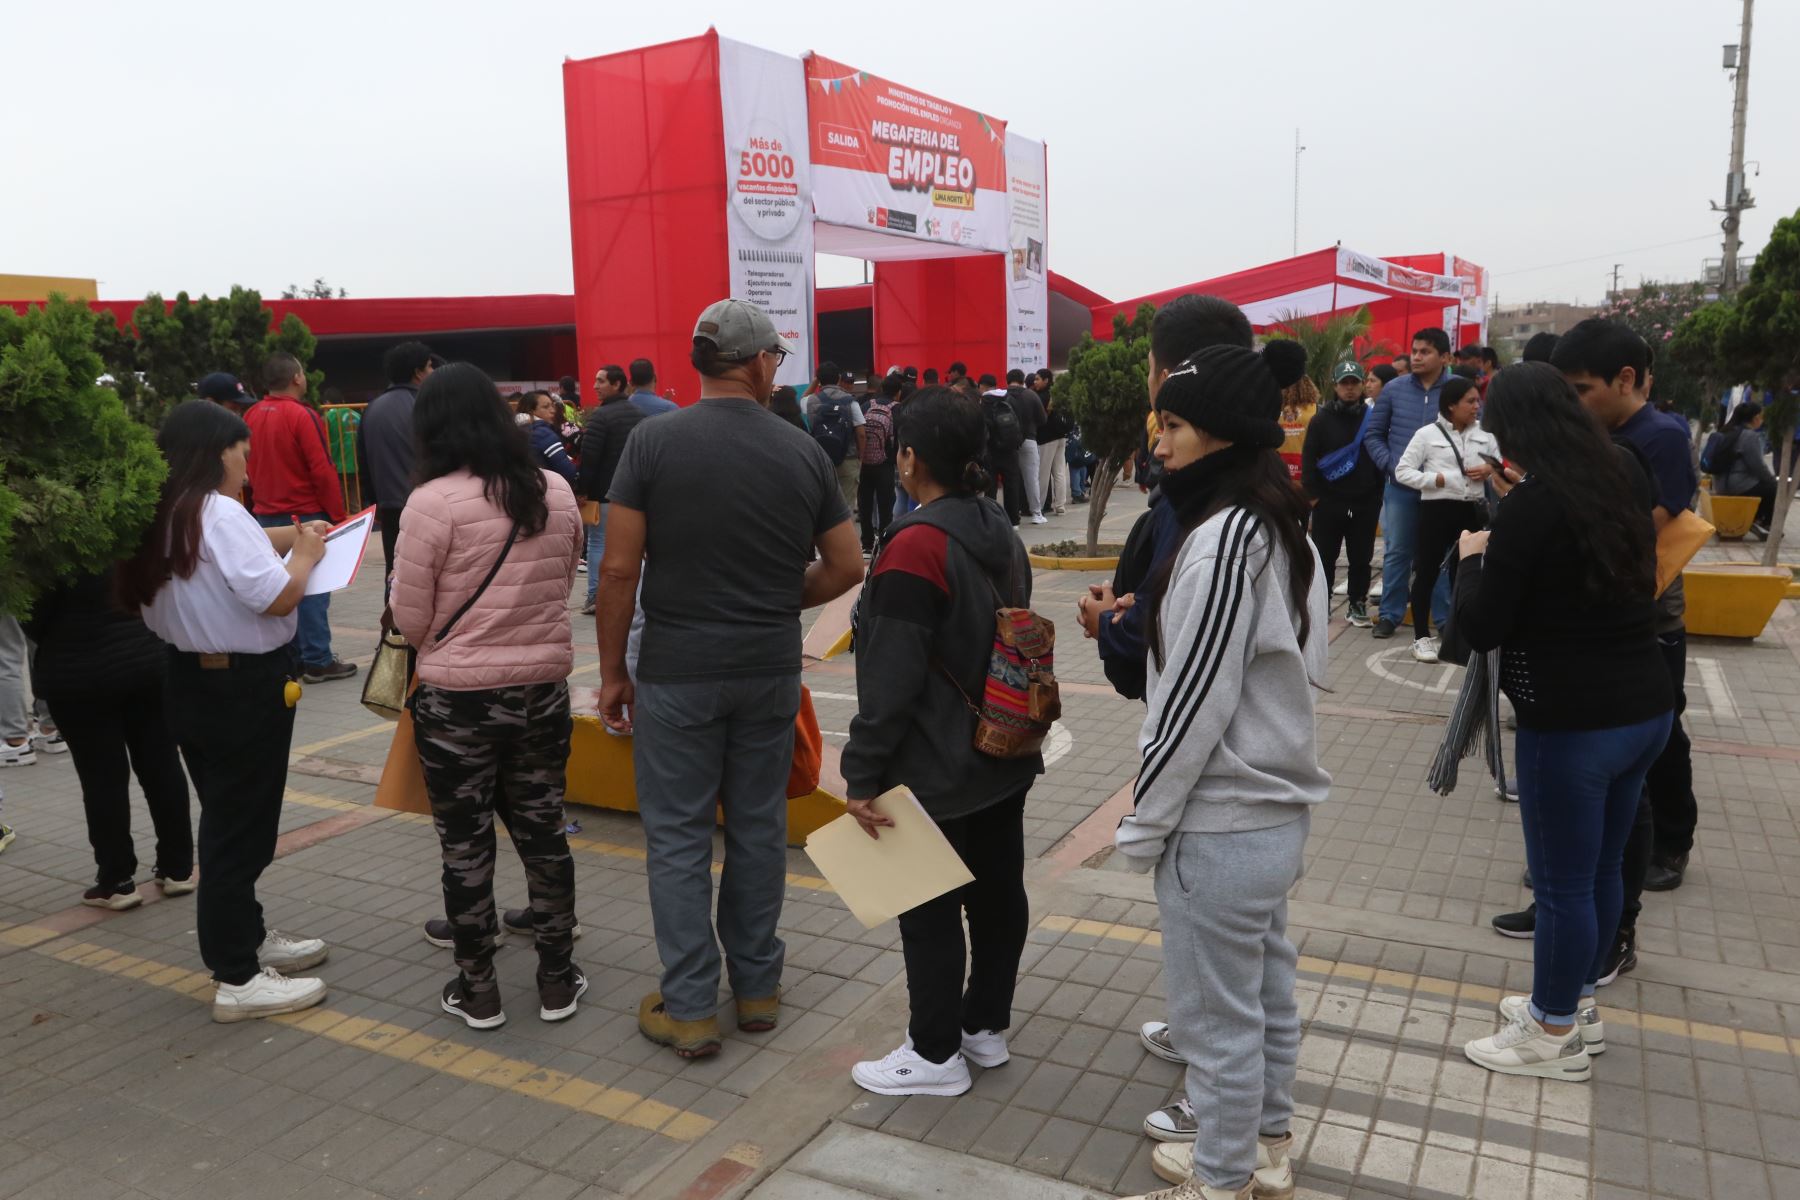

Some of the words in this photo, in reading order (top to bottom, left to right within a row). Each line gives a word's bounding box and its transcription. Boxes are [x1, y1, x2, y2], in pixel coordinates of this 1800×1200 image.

[877, 95, 910, 113] PROMOCIÓN
[910, 106, 920, 117] DEL
[920, 109, 940, 122] EMPLEO
[888, 87, 918, 104] MINISTERIO
[927, 100, 949, 115] TRABAJO
[750, 137, 769, 150] Más
[771, 139, 783, 151] de
[828, 131, 860, 149] SALIDA
[871, 119, 939, 147] MEGAFERIA
[939, 132, 960, 151] DEL
[740, 151, 794, 179] 5000
[888, 146, 974, 188] EMPLEO
[743, 196, 754, 205] del
[754, 198, 773, 206] sector
[774, 198, 796, 208] público
[935, 193, 947, 202] LIMA
[947, 195, 963, 205] NORTE
[762, 208, 786, 218] privado
